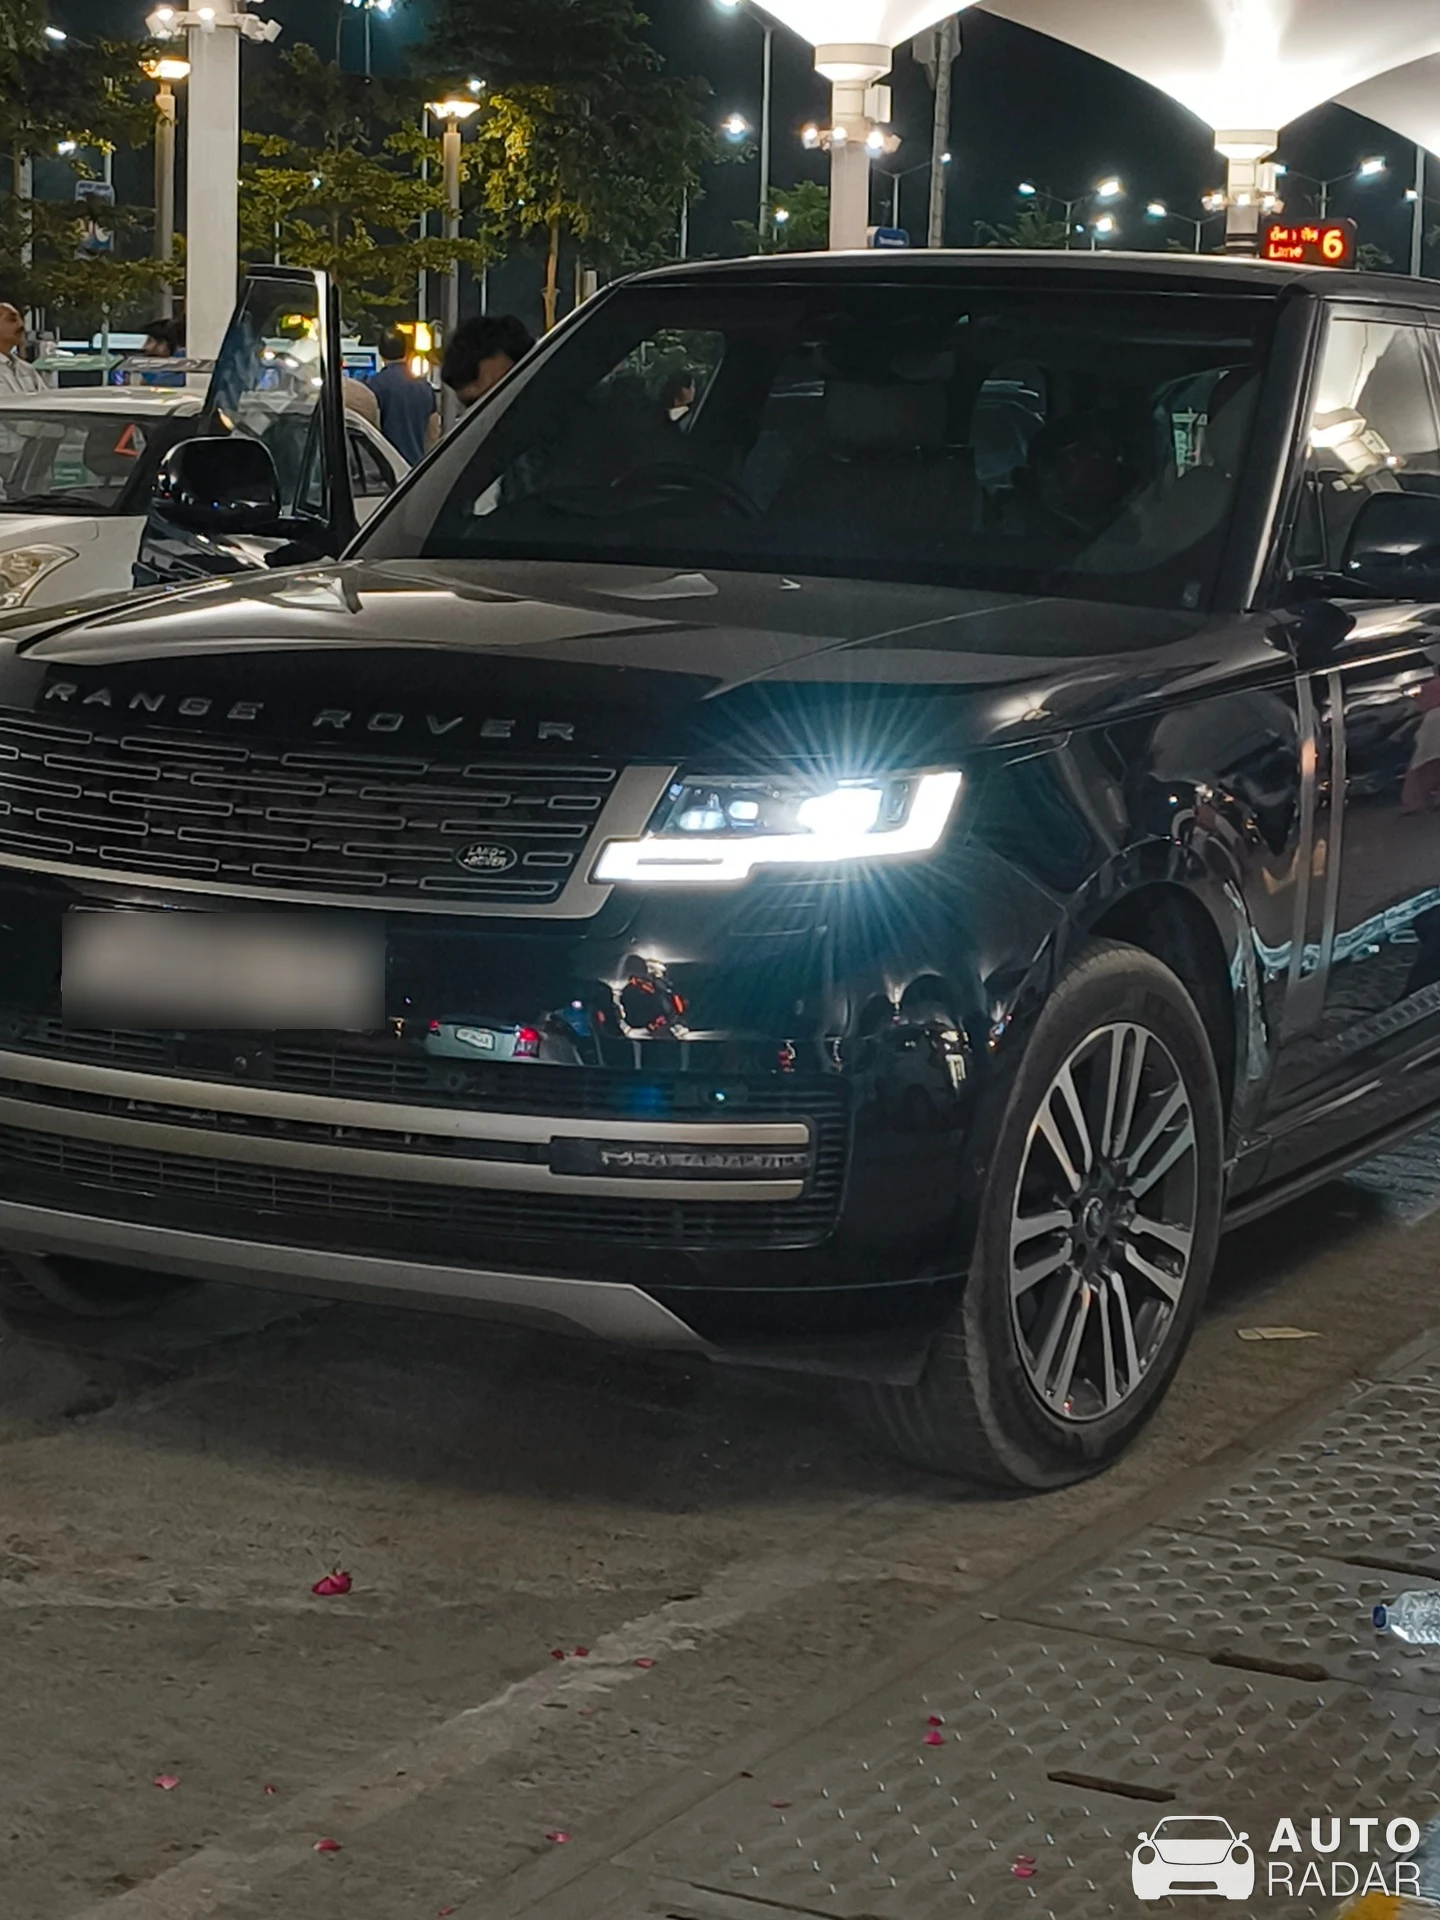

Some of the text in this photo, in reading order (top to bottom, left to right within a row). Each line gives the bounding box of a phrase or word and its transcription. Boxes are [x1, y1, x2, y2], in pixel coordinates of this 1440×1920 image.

[1322, 228, 1343, 259] 6
[45, 683, 575, 741] RANGE ROVER
